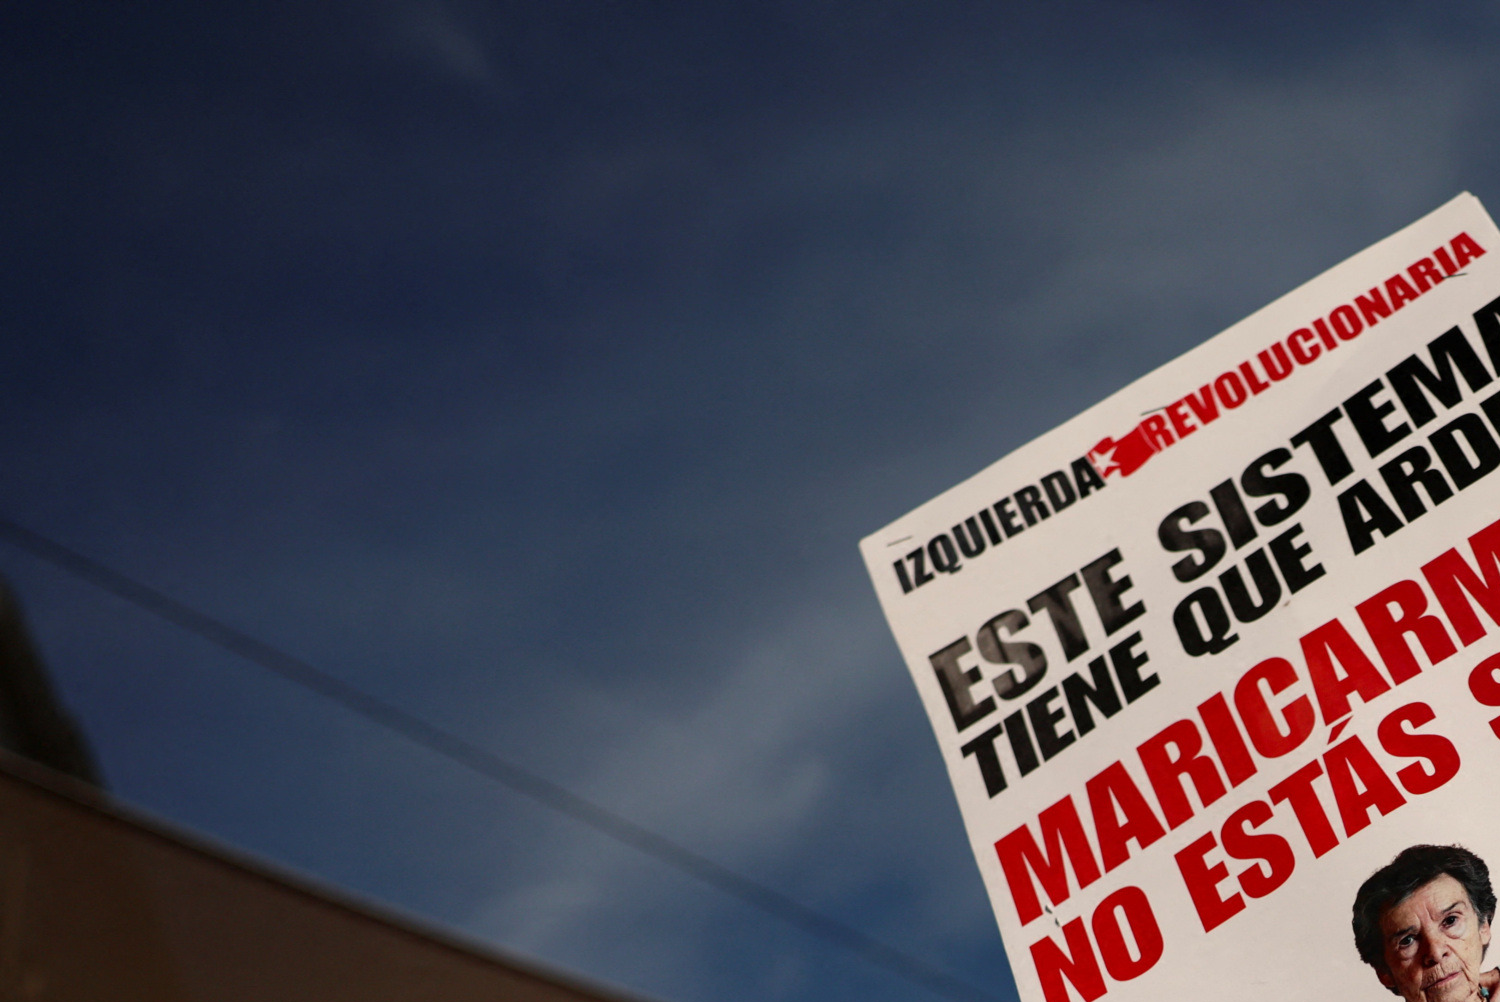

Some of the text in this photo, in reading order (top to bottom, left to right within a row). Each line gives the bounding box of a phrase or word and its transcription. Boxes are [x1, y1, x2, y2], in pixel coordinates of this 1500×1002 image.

[894, 231, 1487, 595] IZQUIERDA REVOLUCIONARIA
[929, 547, 1147, 731] ESTE
[961, 630, 1161, 799] TIENE
[1173, 522, 1326, 657] QUE
[1174, 702, 1462, 934] ESTÁS
